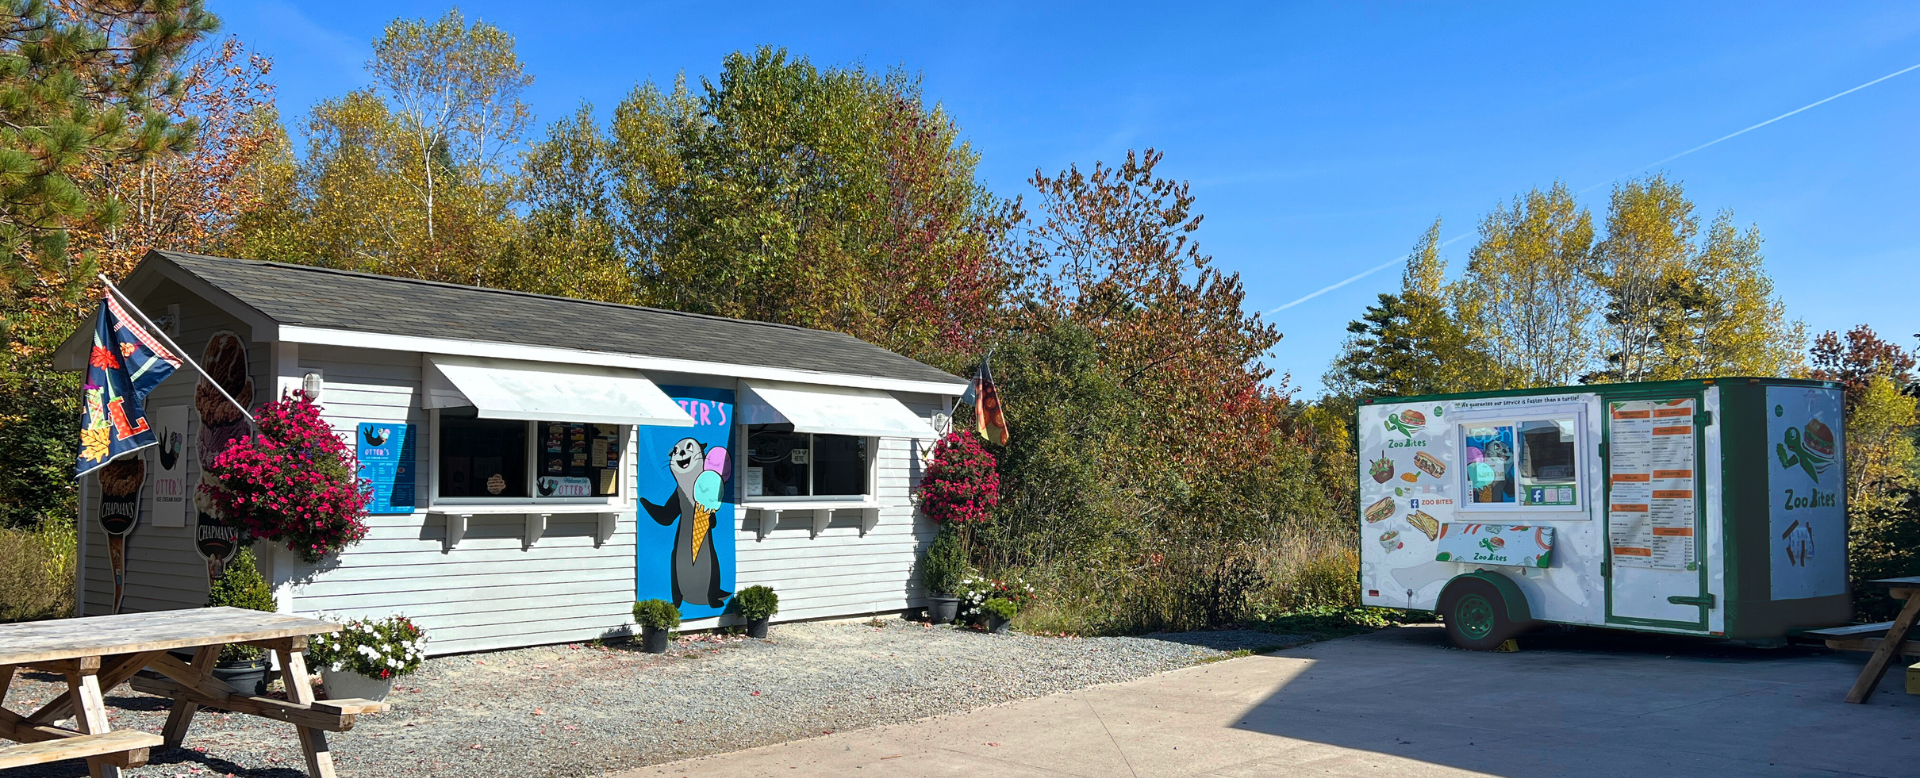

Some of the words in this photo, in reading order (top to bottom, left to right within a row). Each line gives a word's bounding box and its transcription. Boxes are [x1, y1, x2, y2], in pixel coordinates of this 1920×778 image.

[1469, 401, 1493, 409] guarantee
[678, 400, 727, 426] TER'S
[1388, 439, 1403, 448] Zoo
[1404, 438, 1426, 447] Bites
[364, 448, 390, 456] OTTER'S
[155, 477, 183, 496] OTTER'S
[558, 484, 591, 496] OTTER'S
[1784, 488, 1808, 511] Zoo
[1809, 487, 1836, 508] Bites
[101, 501, 135, 519] CHAPMAN'S
[198, 524, 234, 543] CHAPMAN'S
[1473, 552, 1487, 560] Zoo
[1487, 553, 1507, 562] Bites
